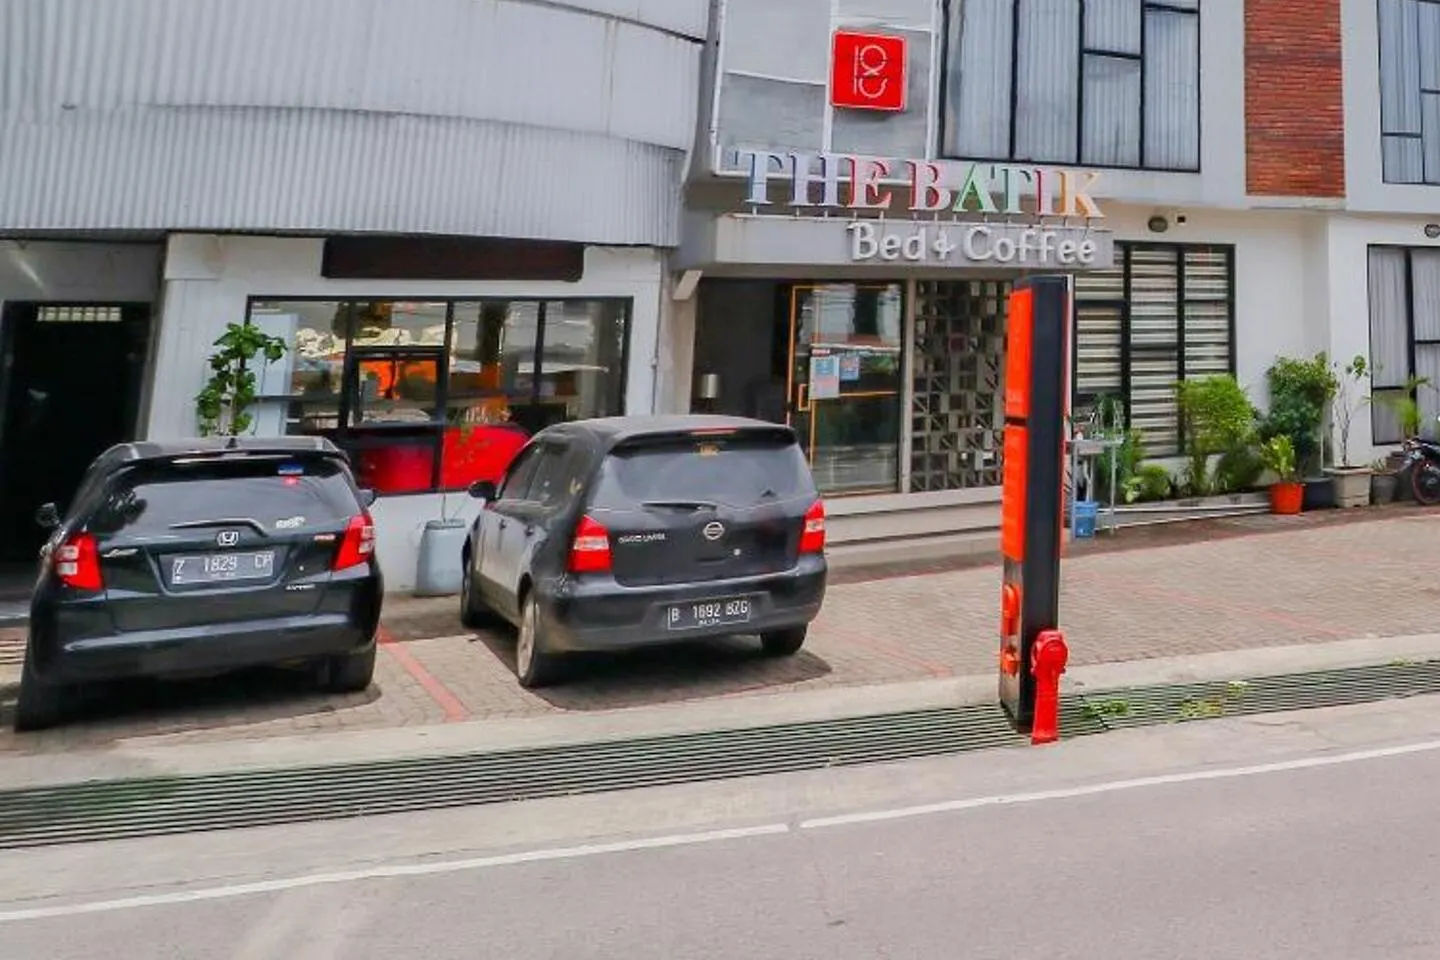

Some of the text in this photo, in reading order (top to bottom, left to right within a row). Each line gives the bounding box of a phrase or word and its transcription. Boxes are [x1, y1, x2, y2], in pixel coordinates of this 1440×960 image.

[732, 150, 1106, 218] THE BATIK
[847, 221, 927, 262] Bed
[963, 225, 1097, 265] Coffee
[671, 607, 680, 622] B
